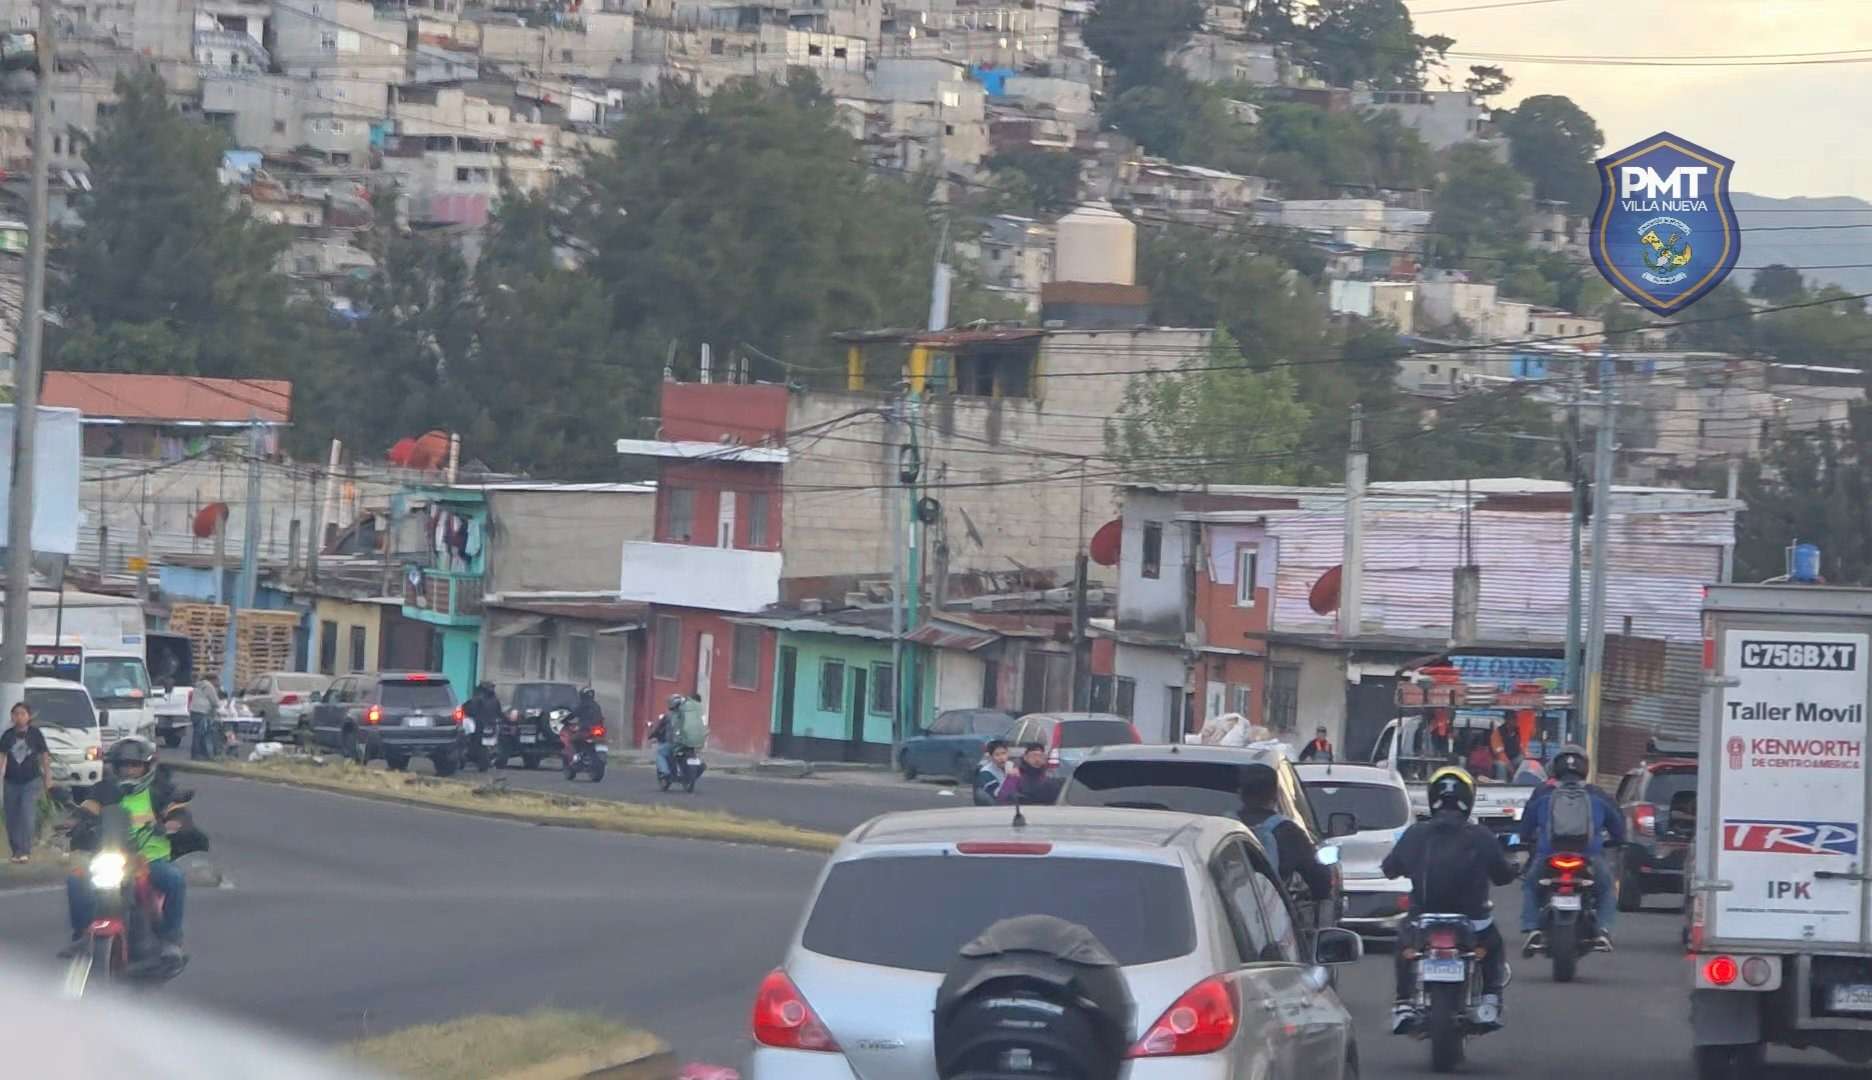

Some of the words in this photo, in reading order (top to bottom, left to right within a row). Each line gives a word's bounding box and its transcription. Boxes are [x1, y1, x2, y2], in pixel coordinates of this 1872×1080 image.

[1743, 643, 1854, 668] C756BXT
[1727, 701, 1791, 721] Taller
[1795, 702, 1862, 723] Movil
[1751, 738, 1861, 757] KENWORTH
[1751, 758, 1766, 768] DE
[1767, 758, 1861, 769] CENTROAMERICA
[1724, 822, 1857, 854] TRP
[1767, 880, 1812, 900] IPK
